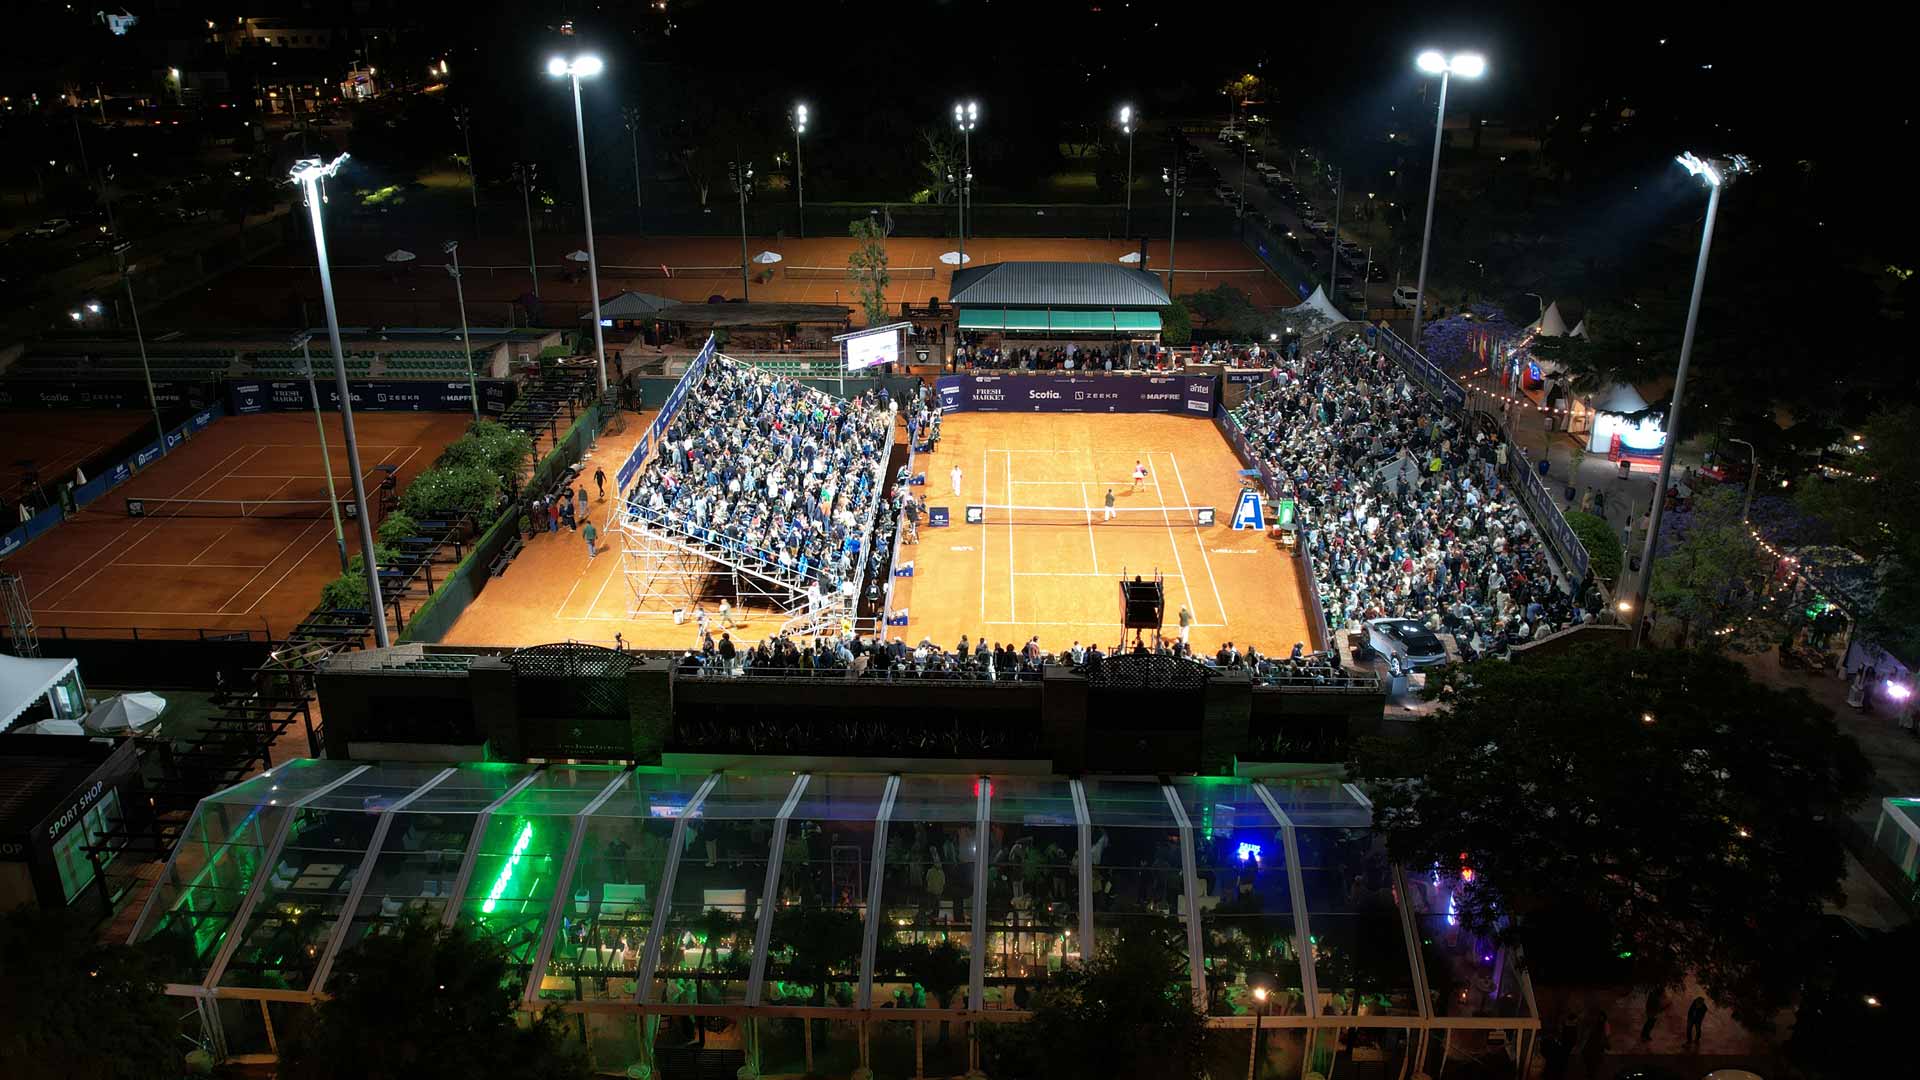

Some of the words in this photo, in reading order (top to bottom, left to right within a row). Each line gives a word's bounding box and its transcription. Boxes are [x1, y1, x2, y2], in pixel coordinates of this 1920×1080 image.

[1189, 383, 1209, 394] antel
[48, 803, 79, 839] SPORT
[80, 781, 103, 810] SHOP
